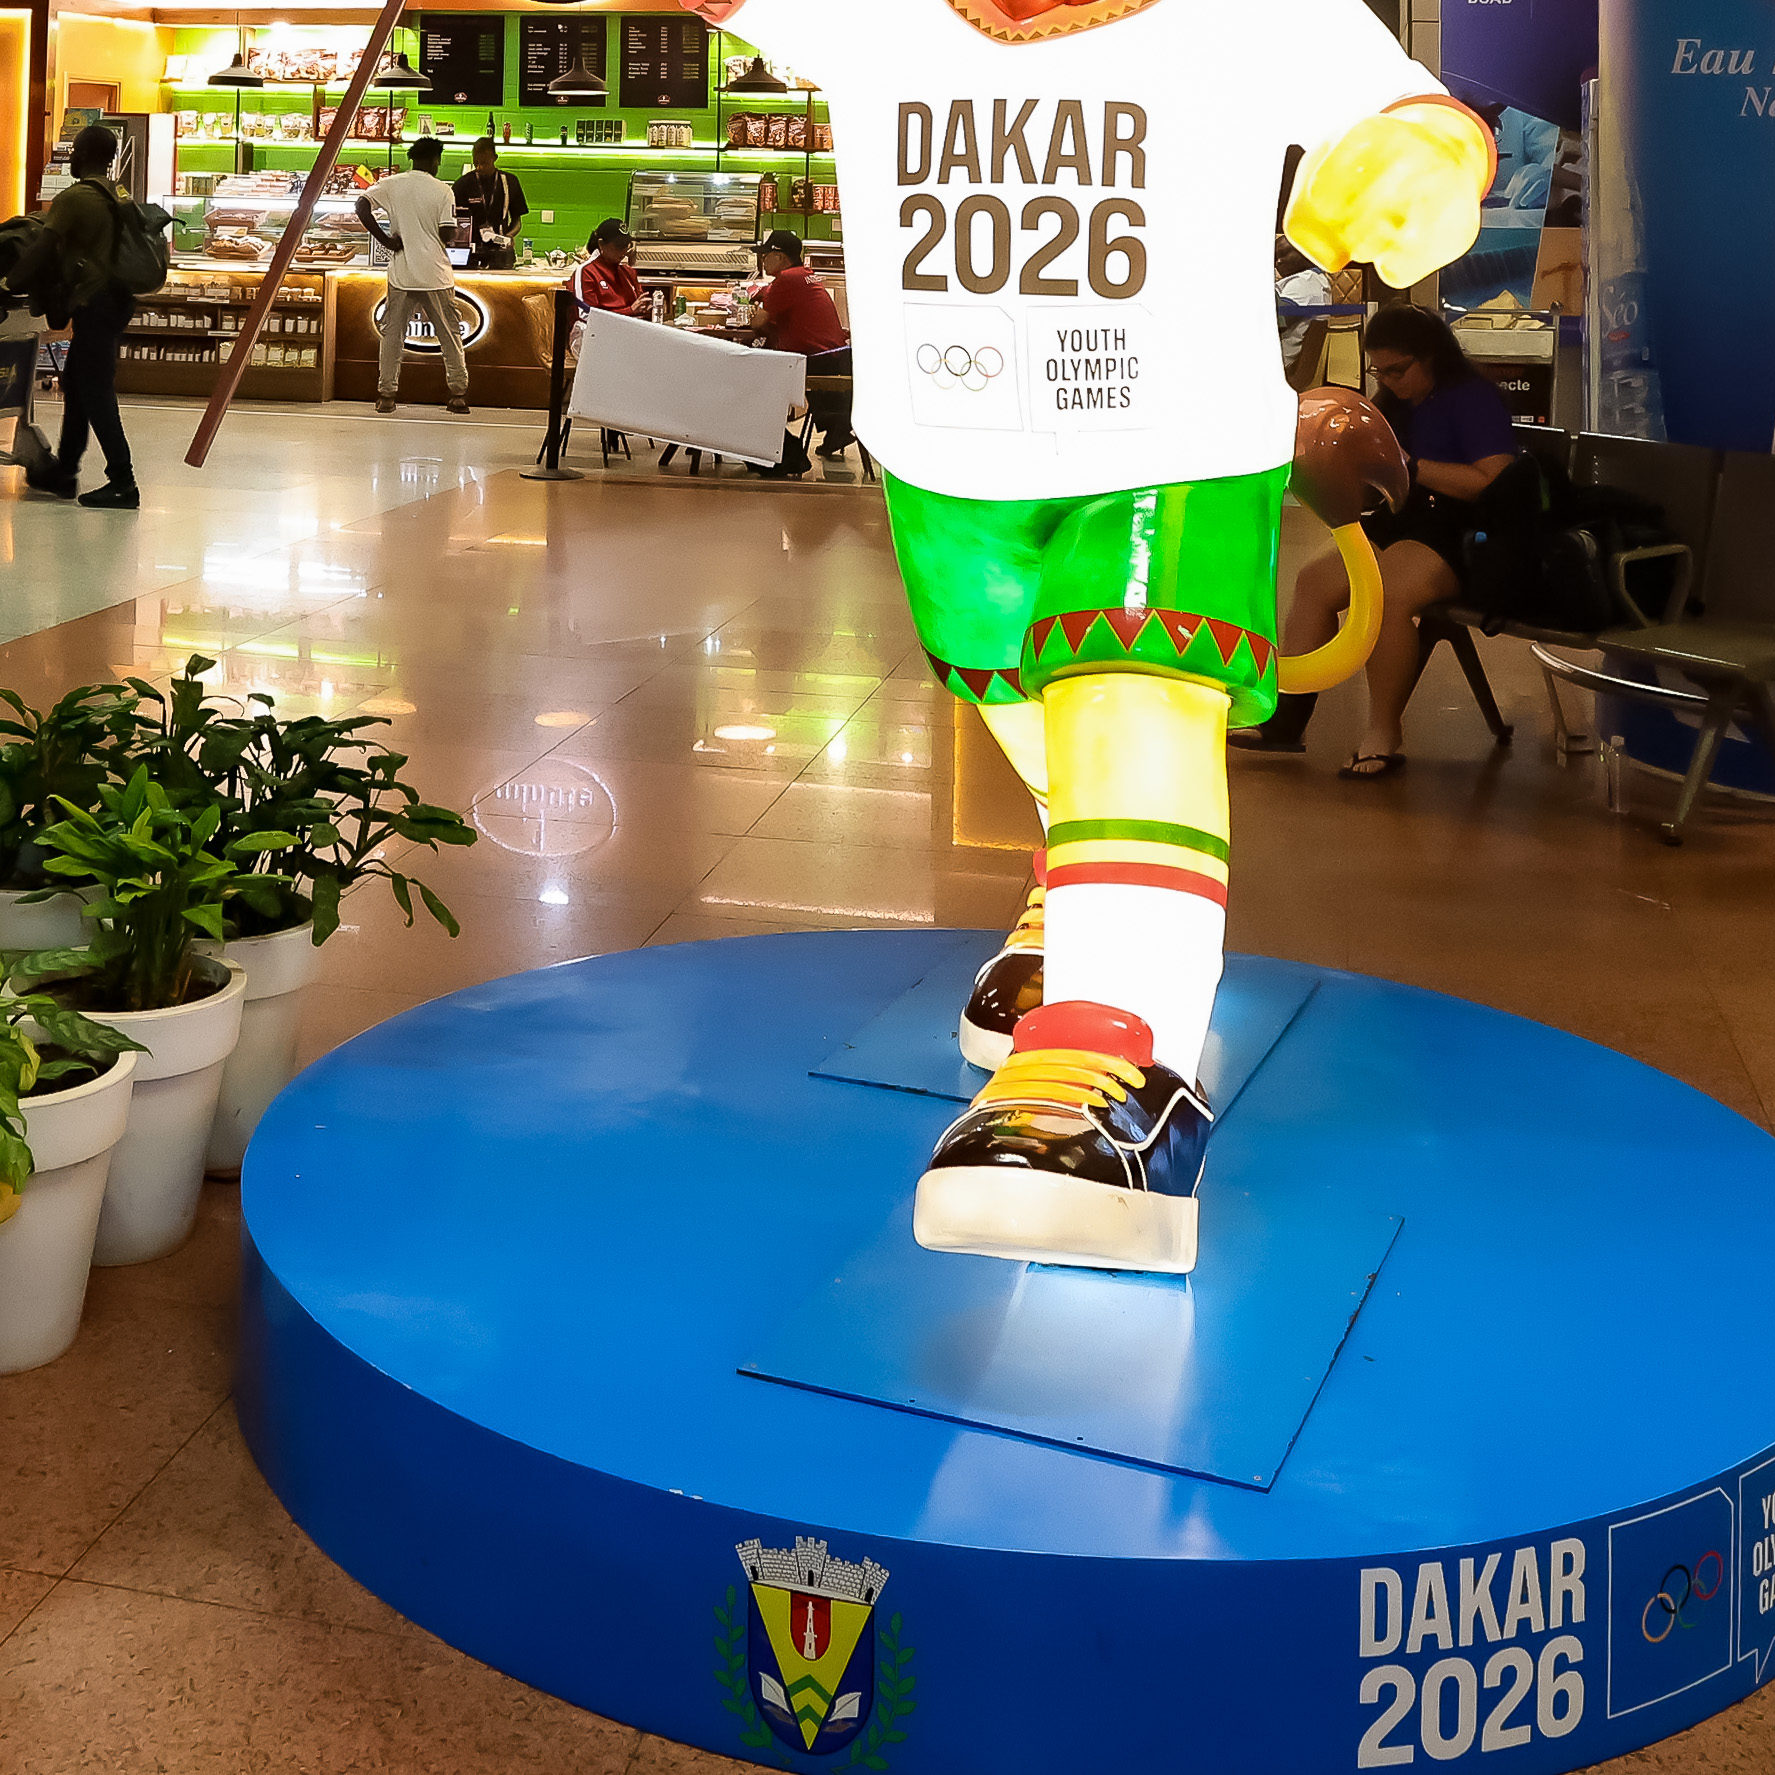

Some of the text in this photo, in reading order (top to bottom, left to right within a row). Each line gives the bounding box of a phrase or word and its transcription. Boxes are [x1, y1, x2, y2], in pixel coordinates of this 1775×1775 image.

[1671, 38, 1755, 76] Eau
[897, 99, 1147, 189] DAKAR
[899, 193, 1147, 299] 2026
[1046, 356, 1139, 382] OLYMPIC
[1057, 328, 1126, 352] YOUTH
[1056, 385, 1131, 411] GAMES
[1359, 1537, 1586, 1658] DAKAR
[1357, 1634, 1584, 1770] 2026
